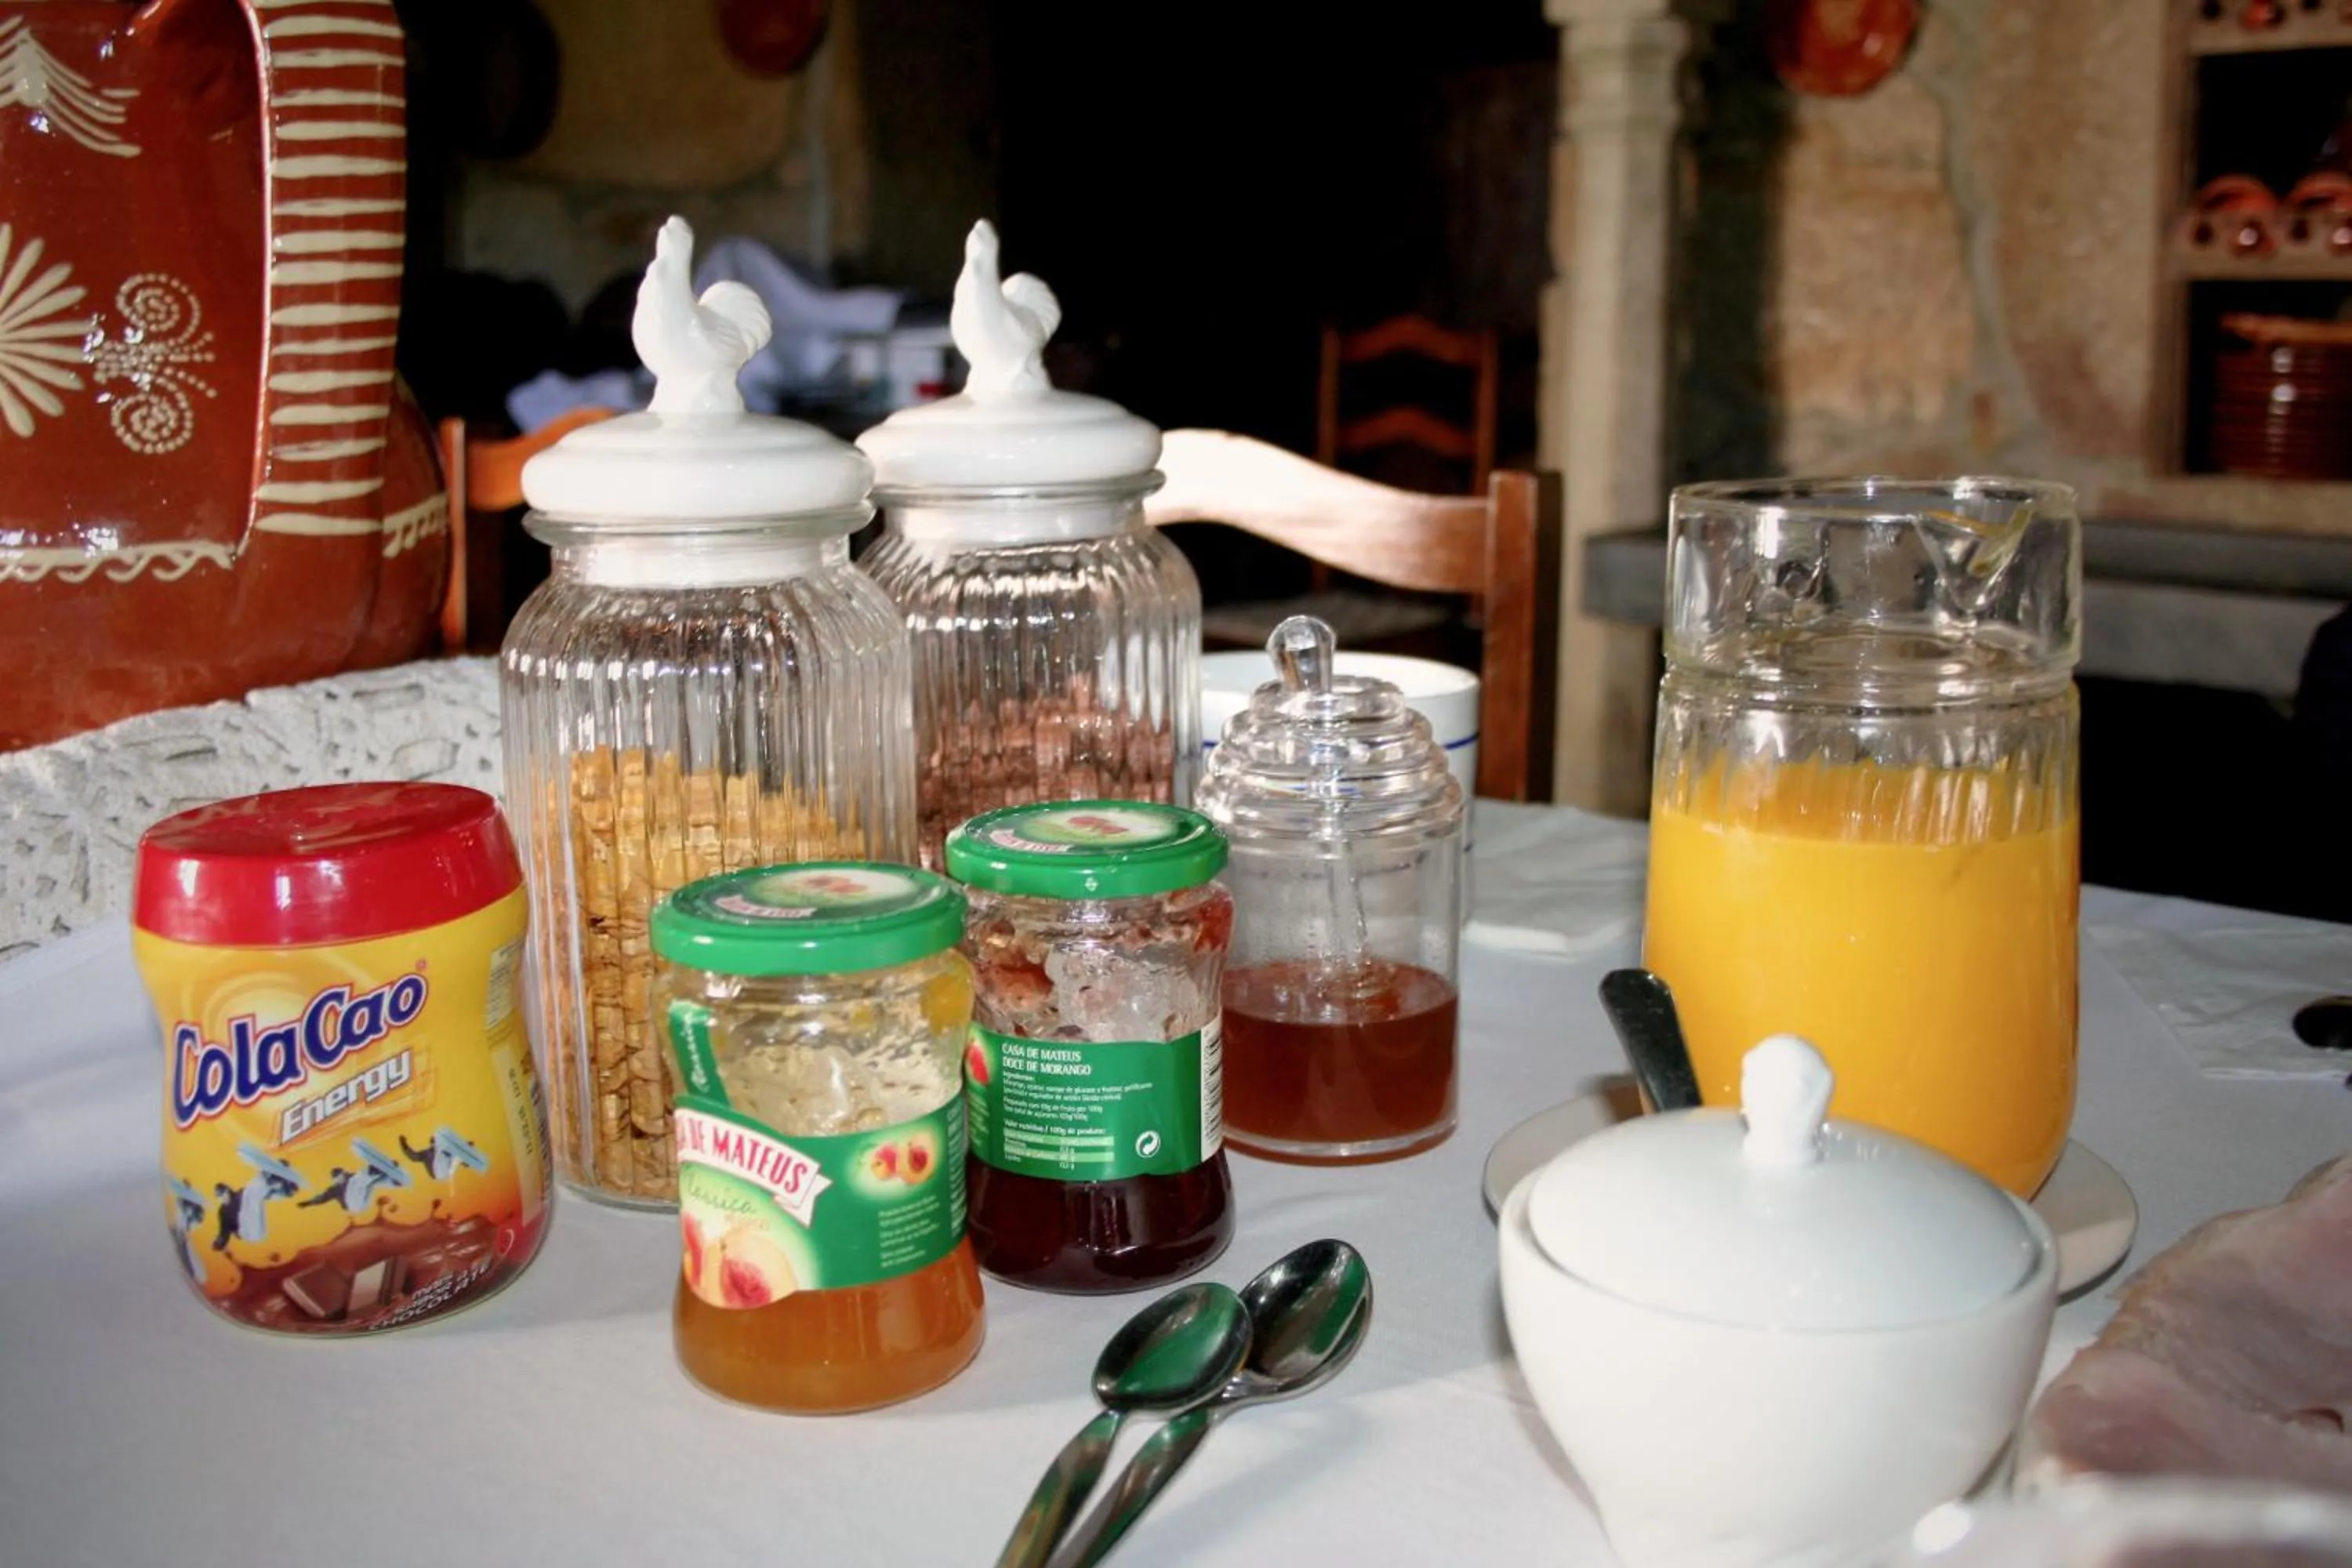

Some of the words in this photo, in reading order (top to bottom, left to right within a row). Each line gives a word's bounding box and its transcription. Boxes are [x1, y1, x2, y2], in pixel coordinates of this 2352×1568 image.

[1002, 1044, 1025, 1057] CASA
[1027, 1047, 1038, 1059] DE
[1040, 1049, 1082, 1062] MATEUS
[1003, 1057, 1025, 1070] DOCE
[1027, 1061, 1038, 1073] DE
[1040, 1063, 1091, 1075] MORANGO
[280, 1048, 414, 1145] Energy
[713, 1126, 808, 1193] MATEUS
